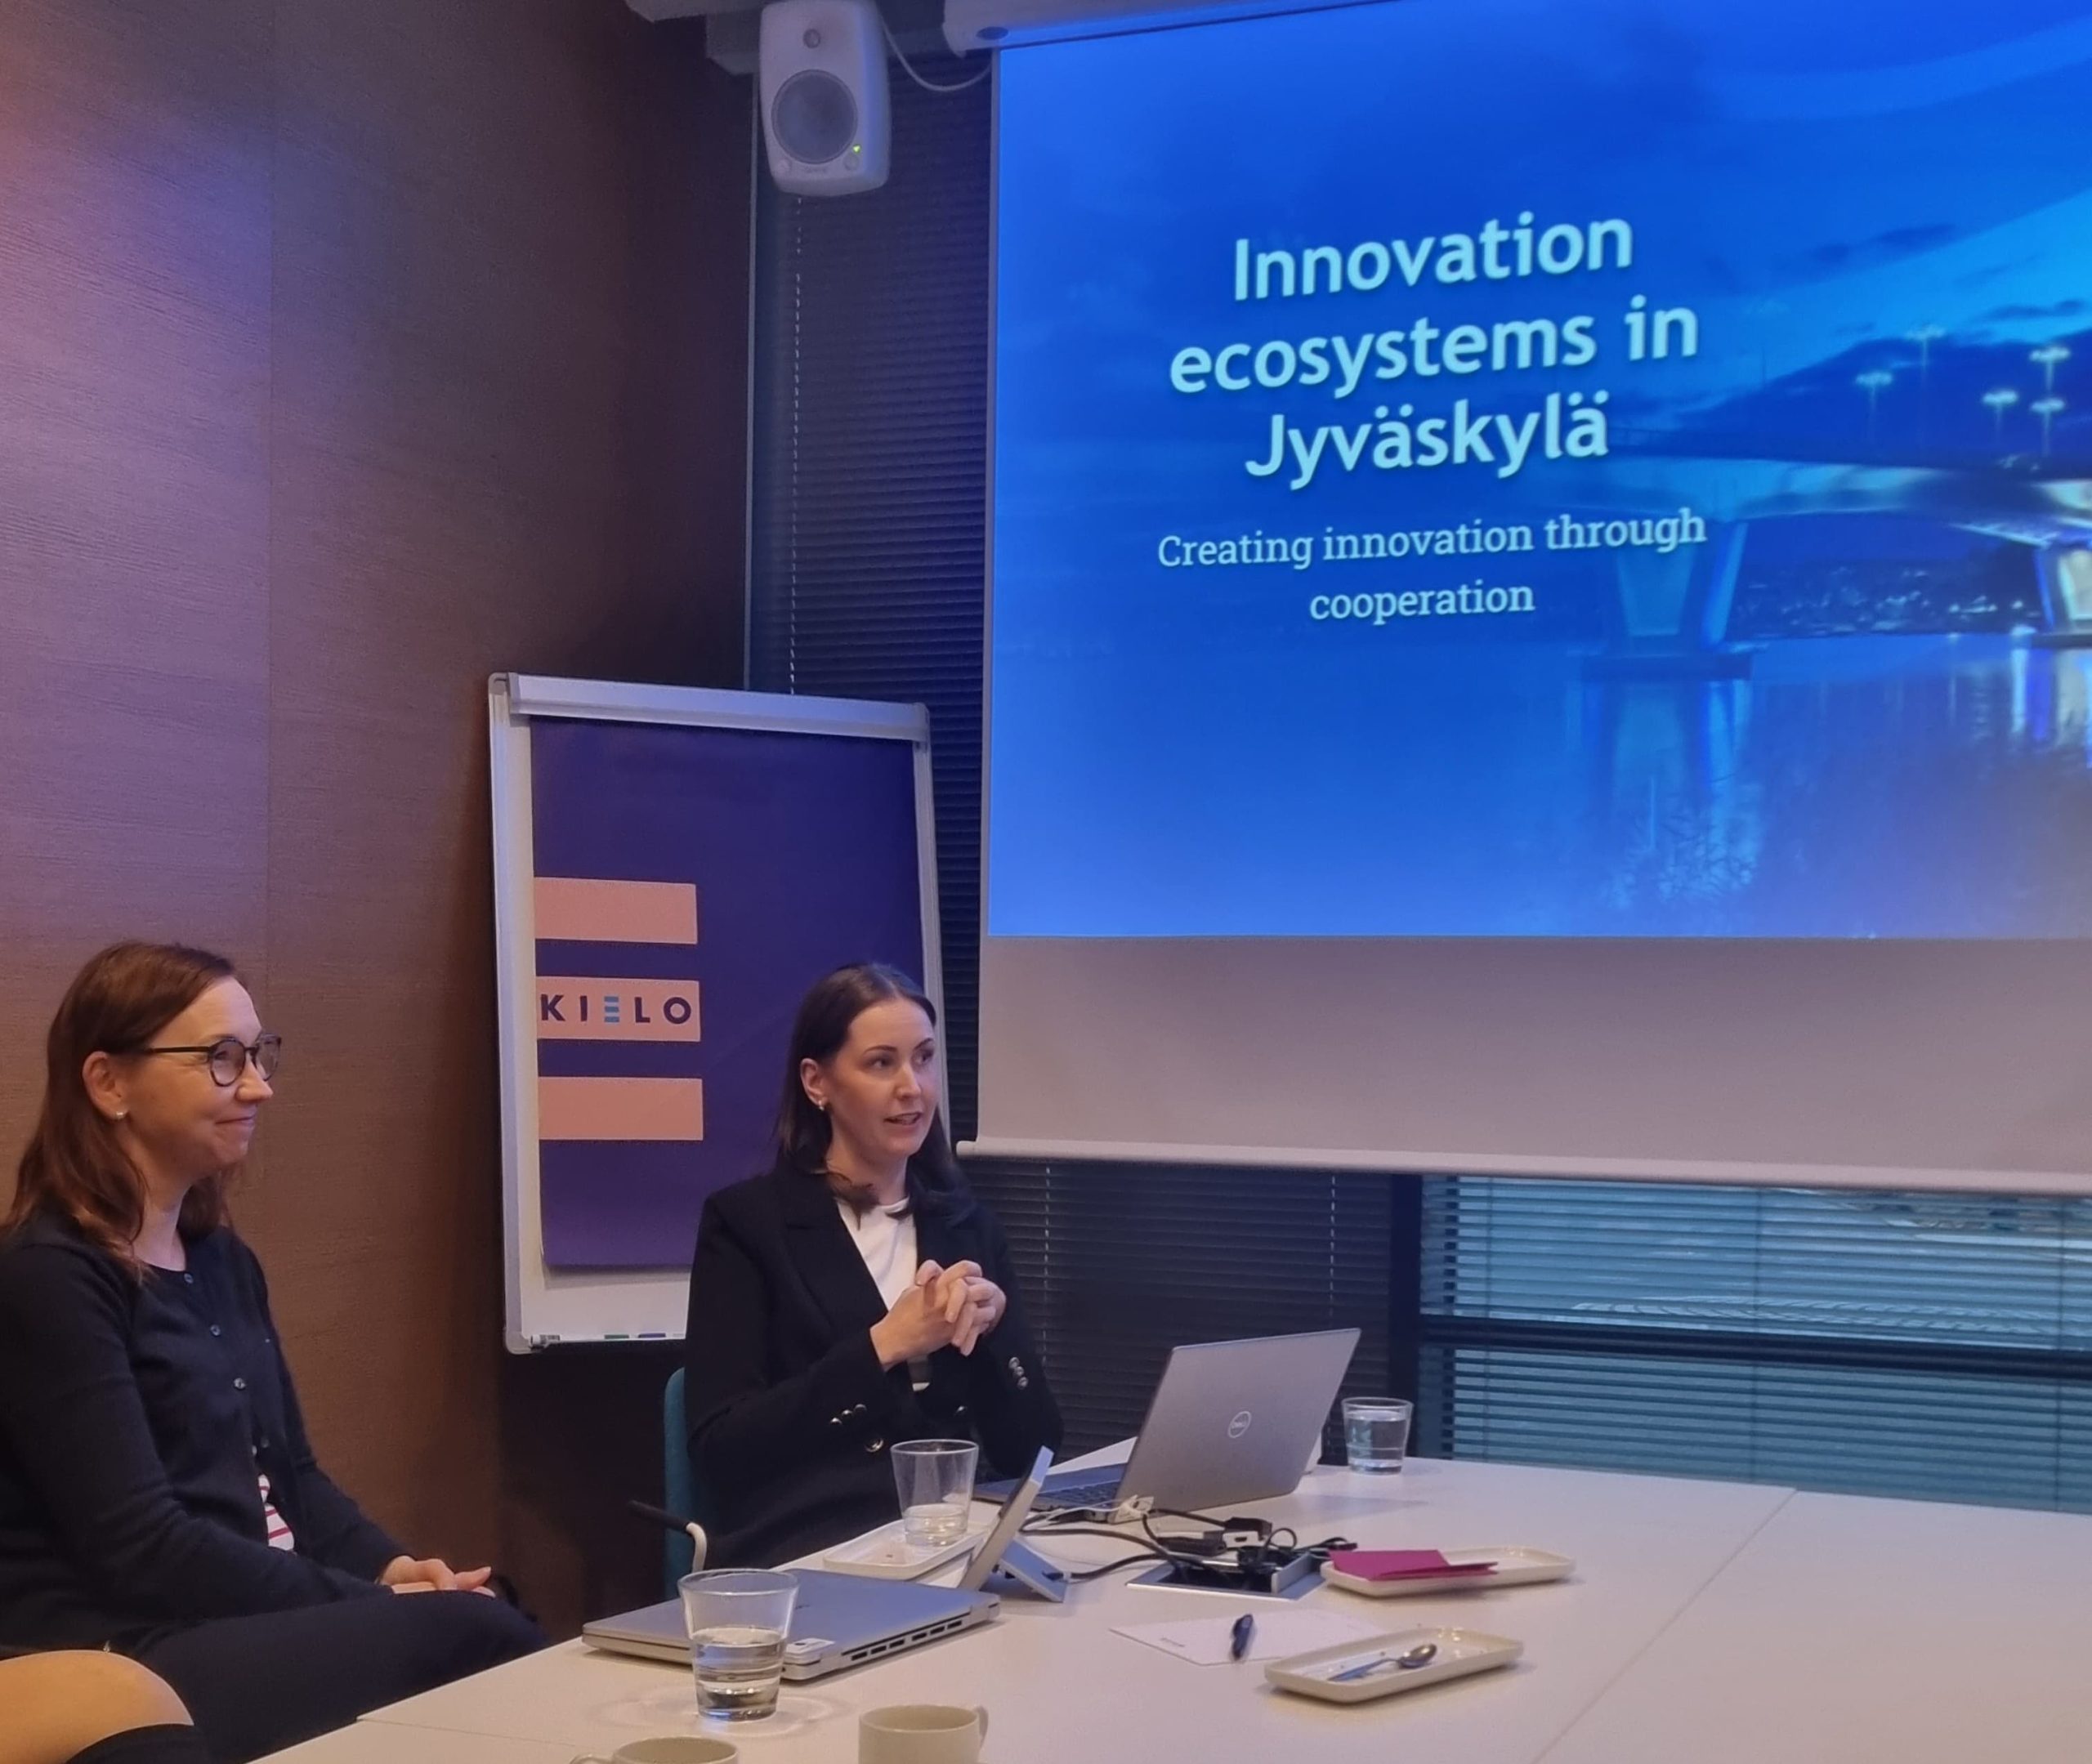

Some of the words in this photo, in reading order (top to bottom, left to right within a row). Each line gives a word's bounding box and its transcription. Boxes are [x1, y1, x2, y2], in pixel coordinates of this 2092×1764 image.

[1236, 212, 1633, 300] Innovation
[1170, 316, 1598, 399] ecosystems
[1625, 295, 1697, 360] in
[1245, 390, 1610, 490] Jyväskylä
[1158, 531, 1313, 570] Creating
[1323, 520, 1534, 560] innovation
[1545, 507, 1707, 554] through
[1310, 579, 1535, 625] cooperation
[540, 994, 692, 1025] KIELO
